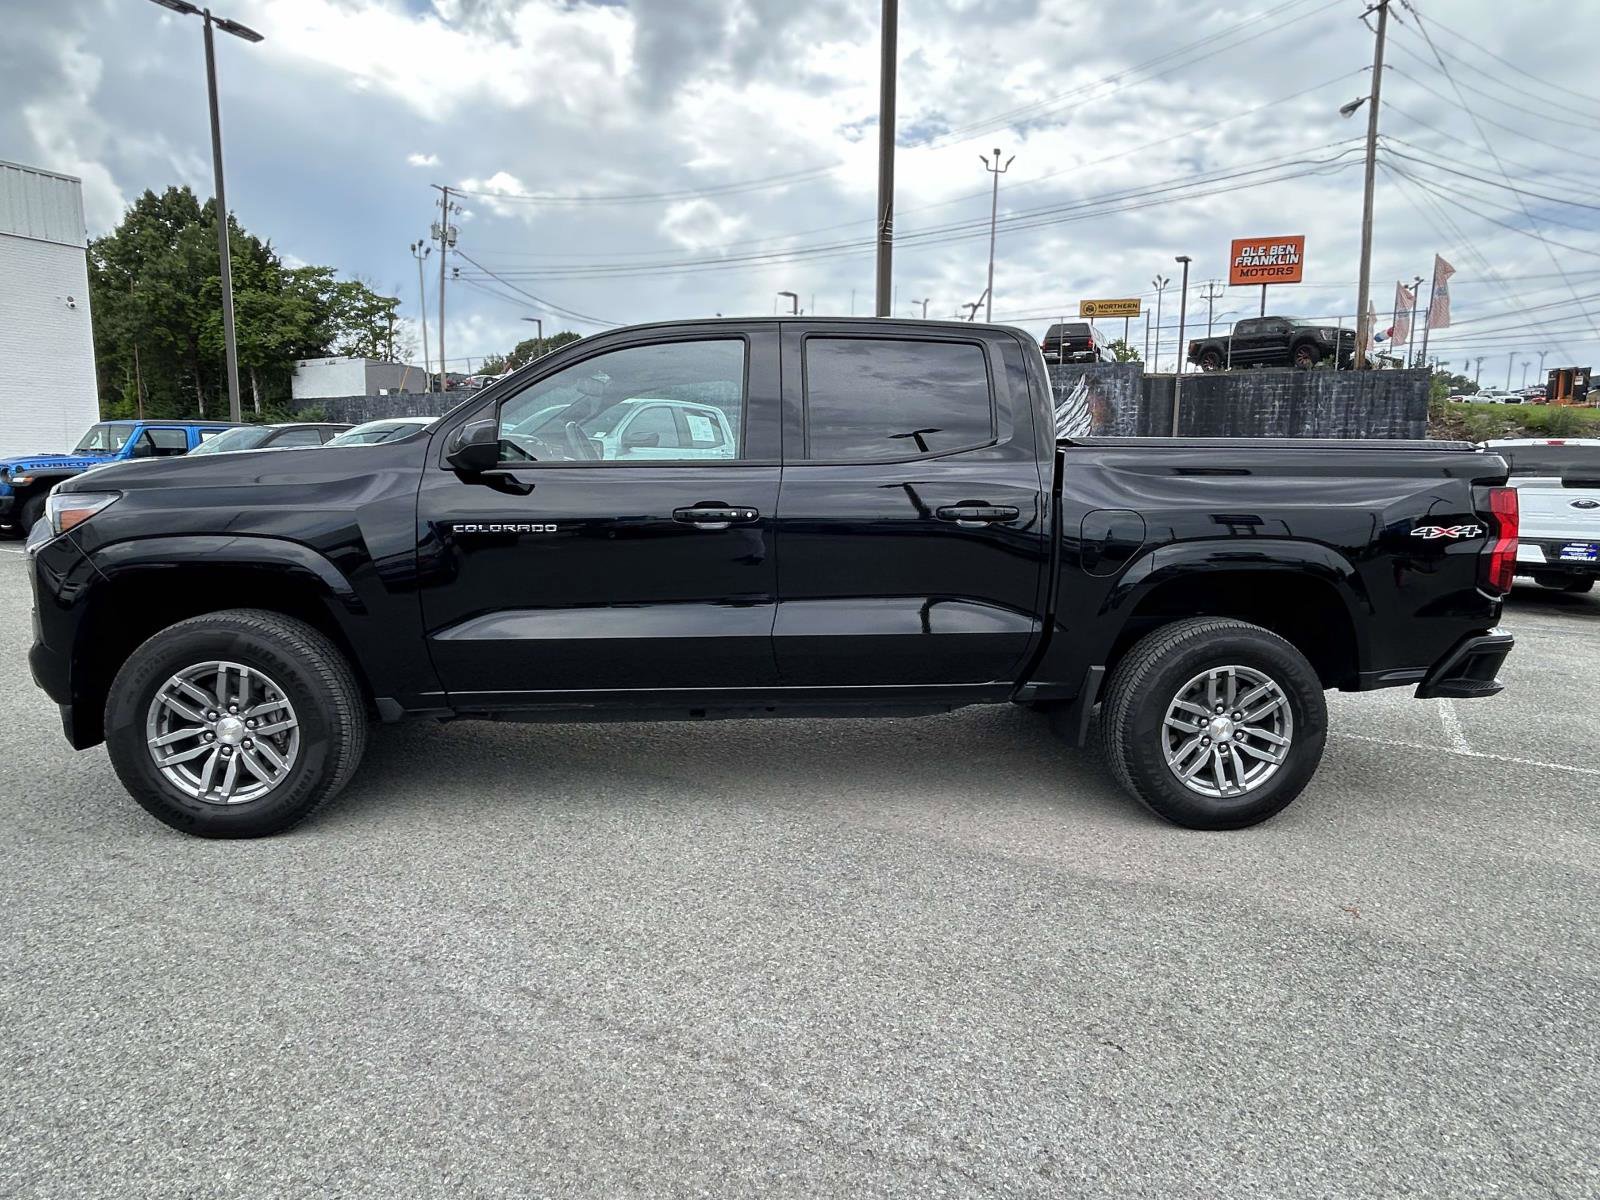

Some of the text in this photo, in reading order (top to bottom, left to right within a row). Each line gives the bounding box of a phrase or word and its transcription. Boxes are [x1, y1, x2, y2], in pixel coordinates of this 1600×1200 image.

[1242, 245, 1296, 257] OLE BEN
[1235, 254, 1299, 267] FRANKLIN
[1240, 267, 1294, 277] MOTORS
[30, 461, 97, 469] RUBICON
[453, 524, 557, 533] COLORADO
